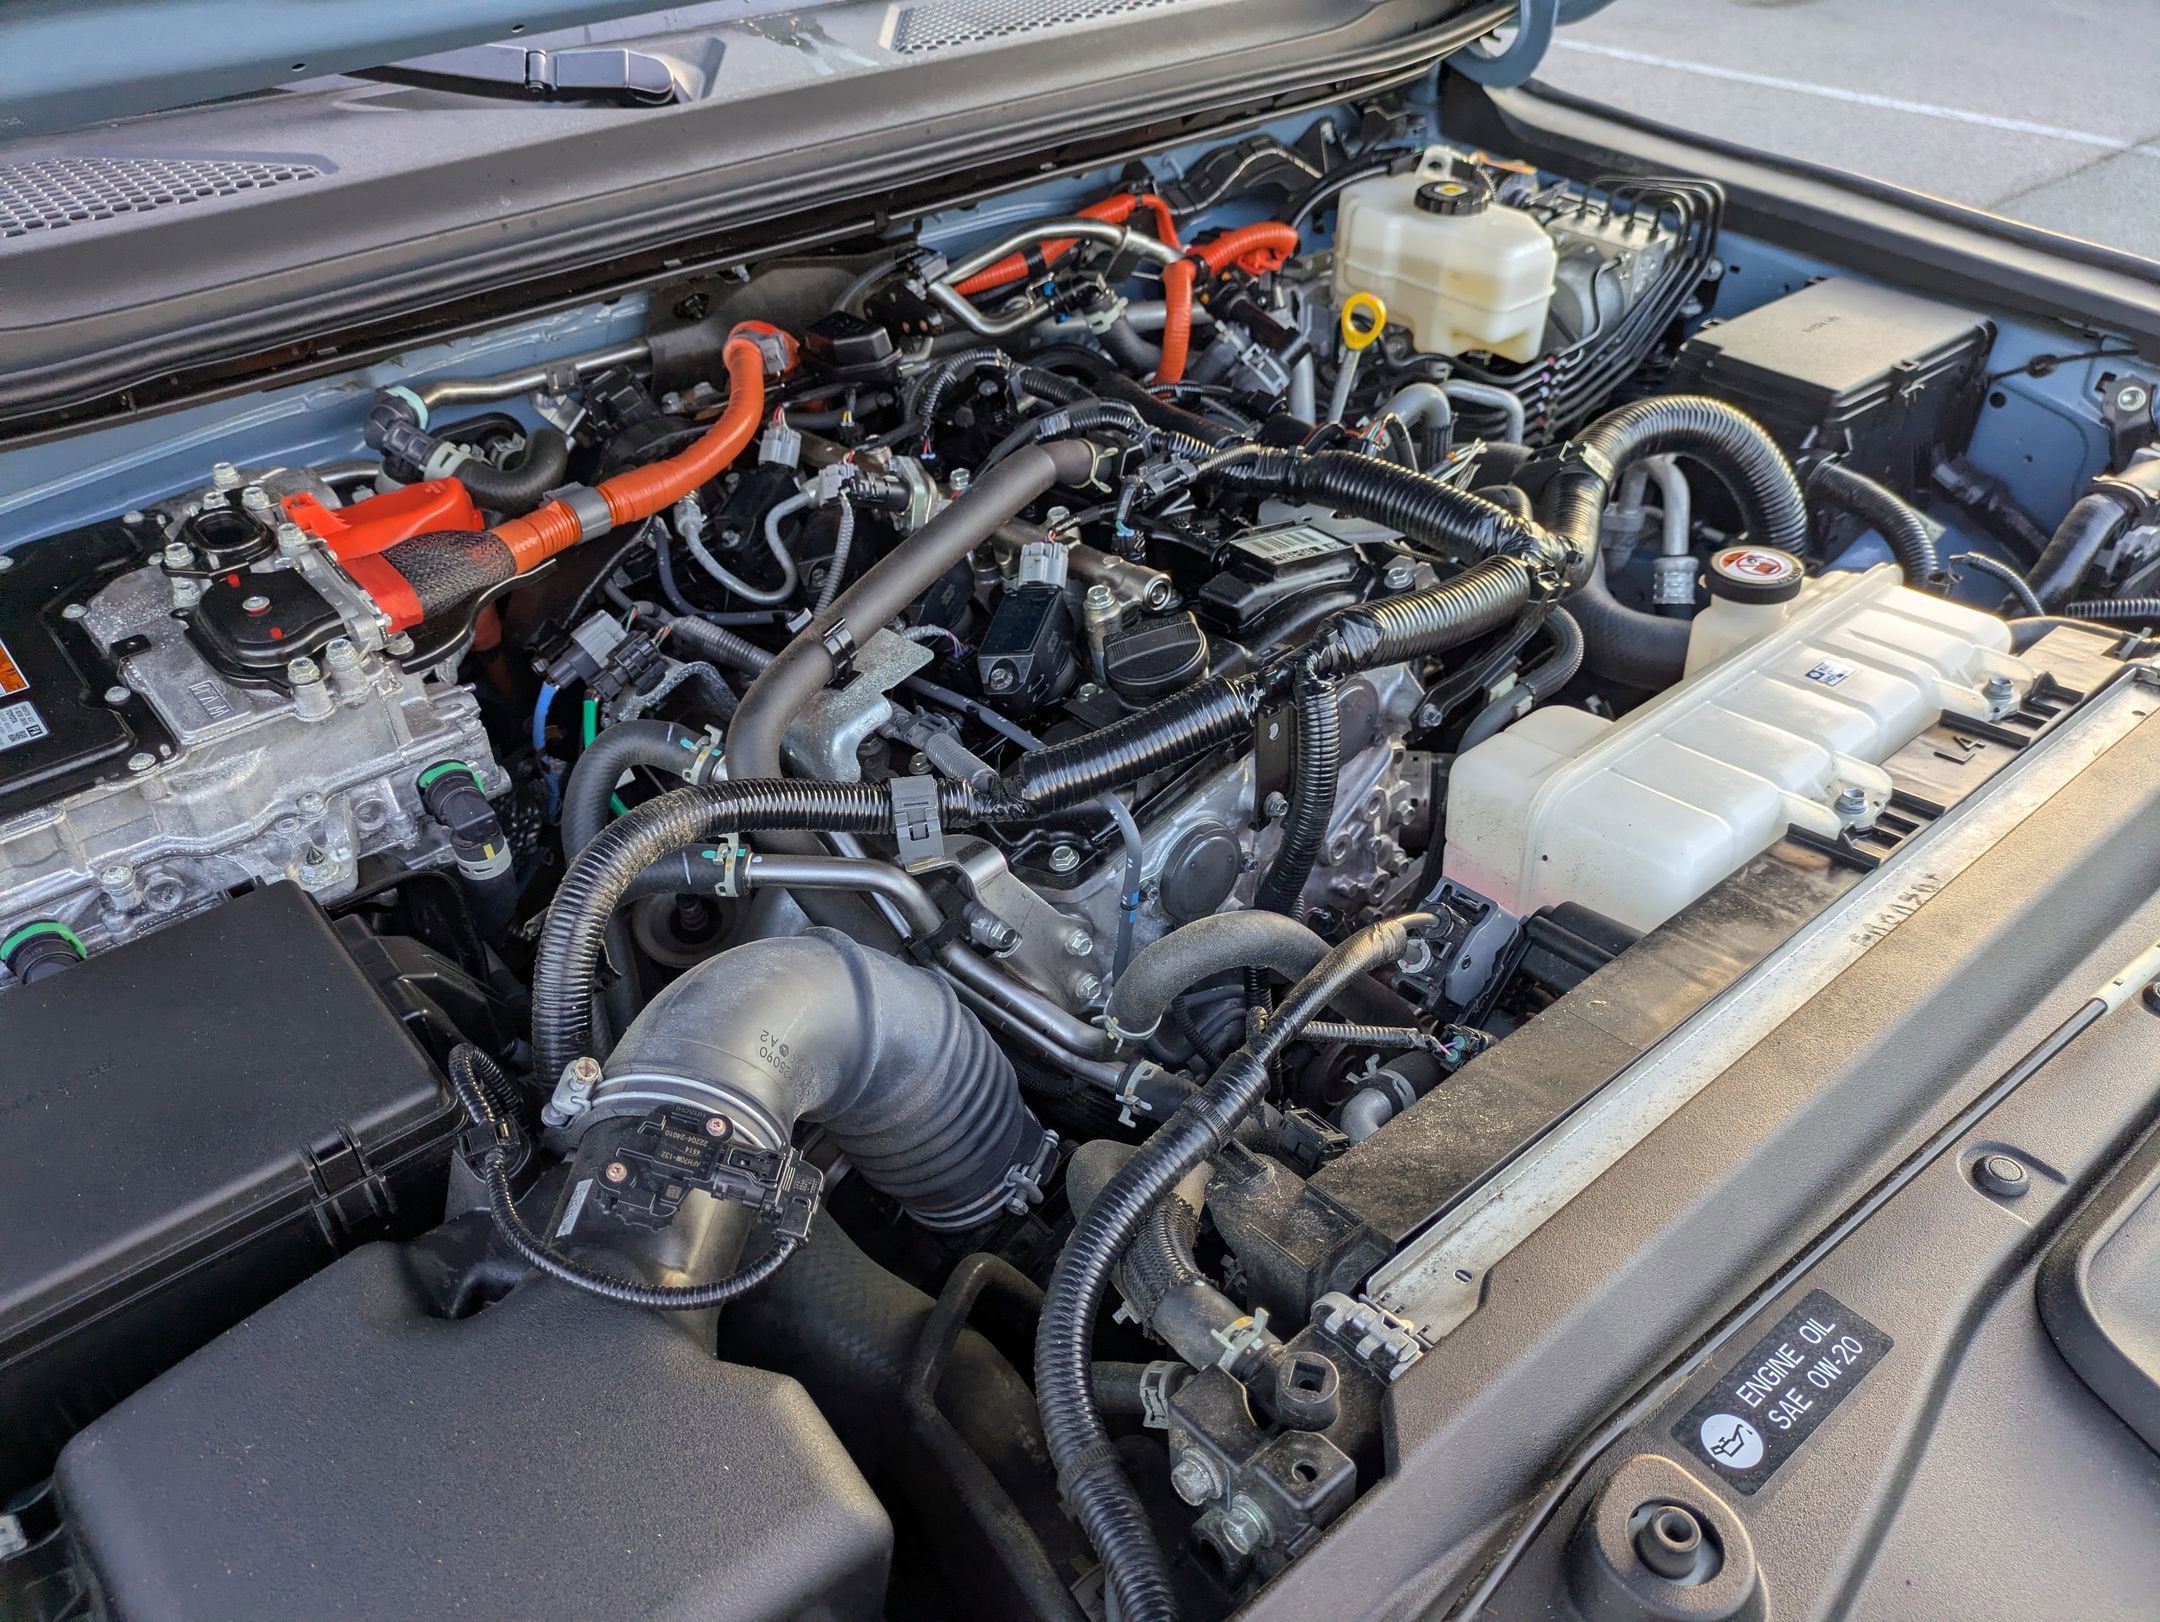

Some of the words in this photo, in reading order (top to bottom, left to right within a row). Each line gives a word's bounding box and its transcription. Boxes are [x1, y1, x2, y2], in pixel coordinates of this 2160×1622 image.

[1735, 1343, 1805, 1408] ENGINE
[1798, 1318, 1836, 1344] OIL
[1768, 1388, 1813, 1430] SAE
[1806, 1336, 1863, 1389] 0W-20
